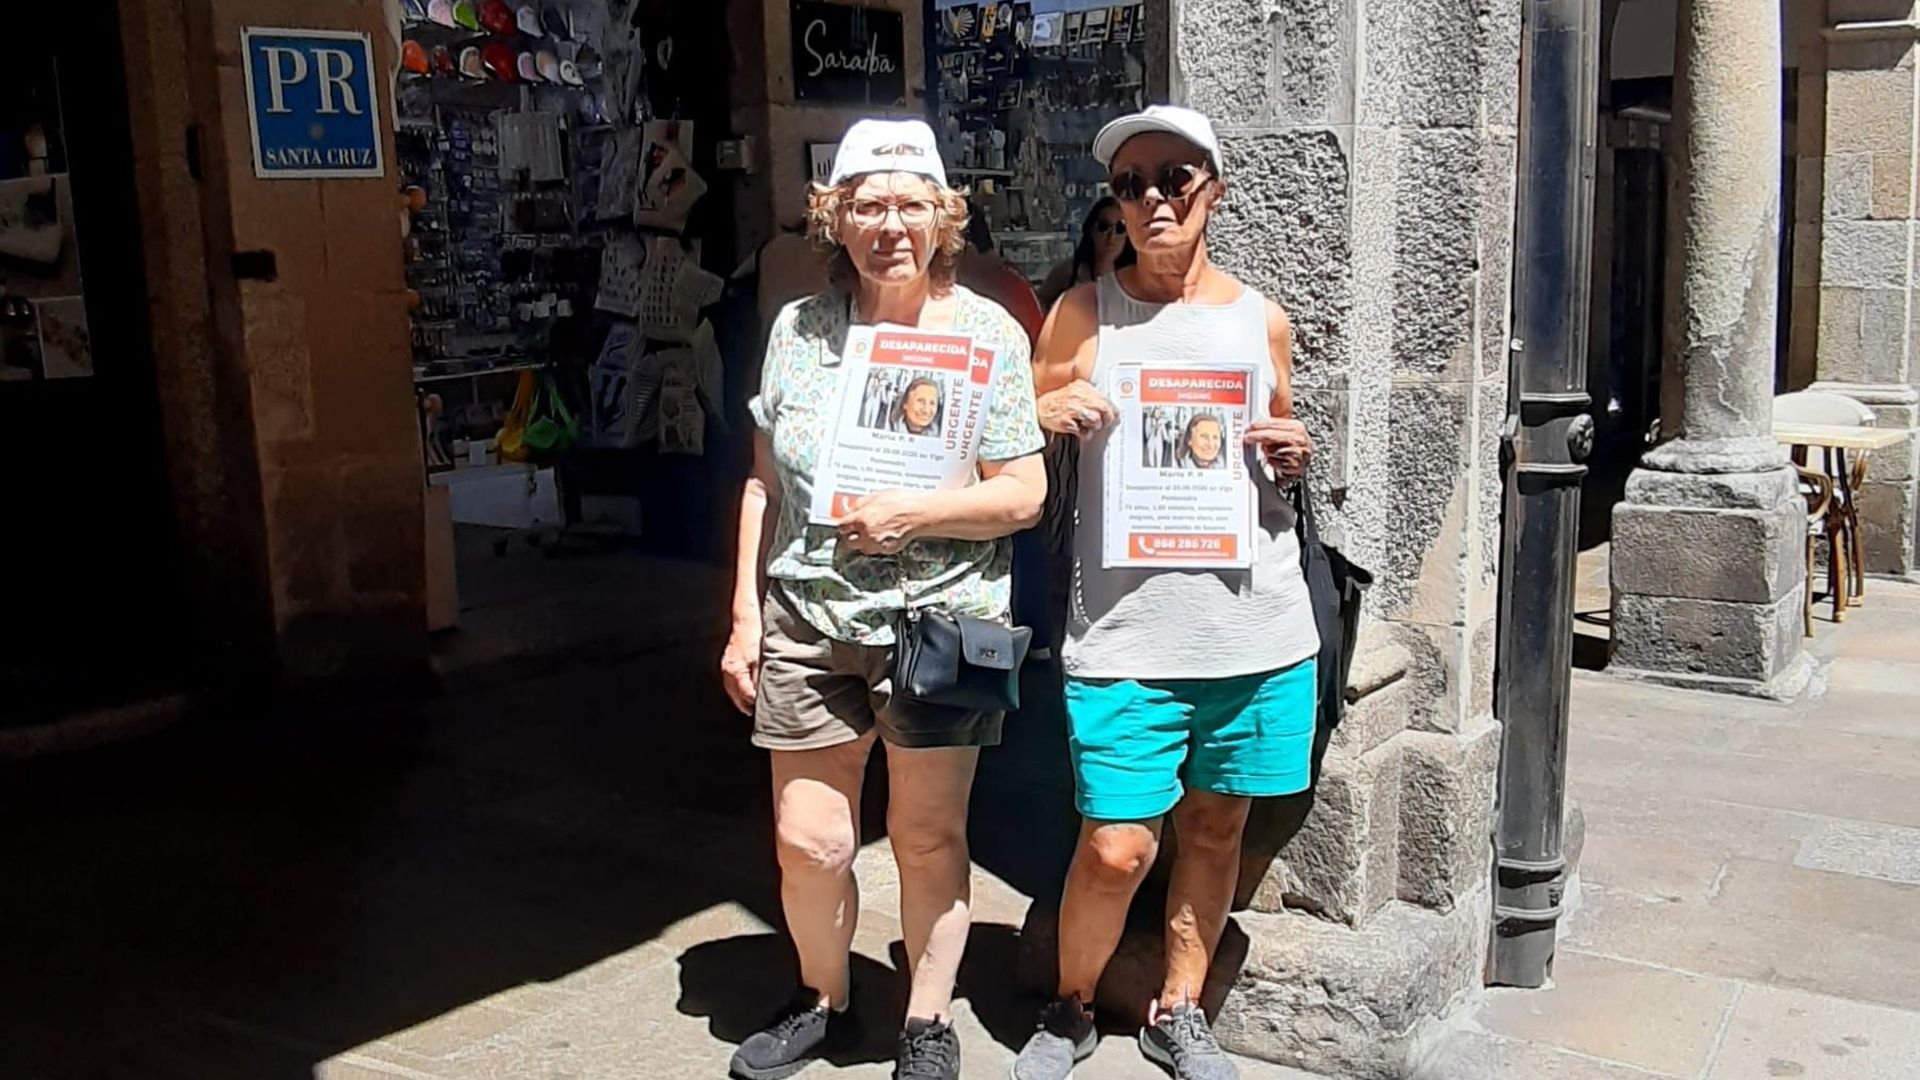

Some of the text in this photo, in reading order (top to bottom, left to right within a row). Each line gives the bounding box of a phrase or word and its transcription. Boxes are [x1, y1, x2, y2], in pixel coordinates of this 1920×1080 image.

[260, 46, 363, 115] PR
[265, 148, 372, 166] SANTA CRUZ
[879, 340, 968, 356] DESAPARECIDA
[1148, 377, 1244, 391] DESAPARECIDA
[945, 377, 964, 450] URGENTE
[1233, 410, 1244, 481] URGENTE
